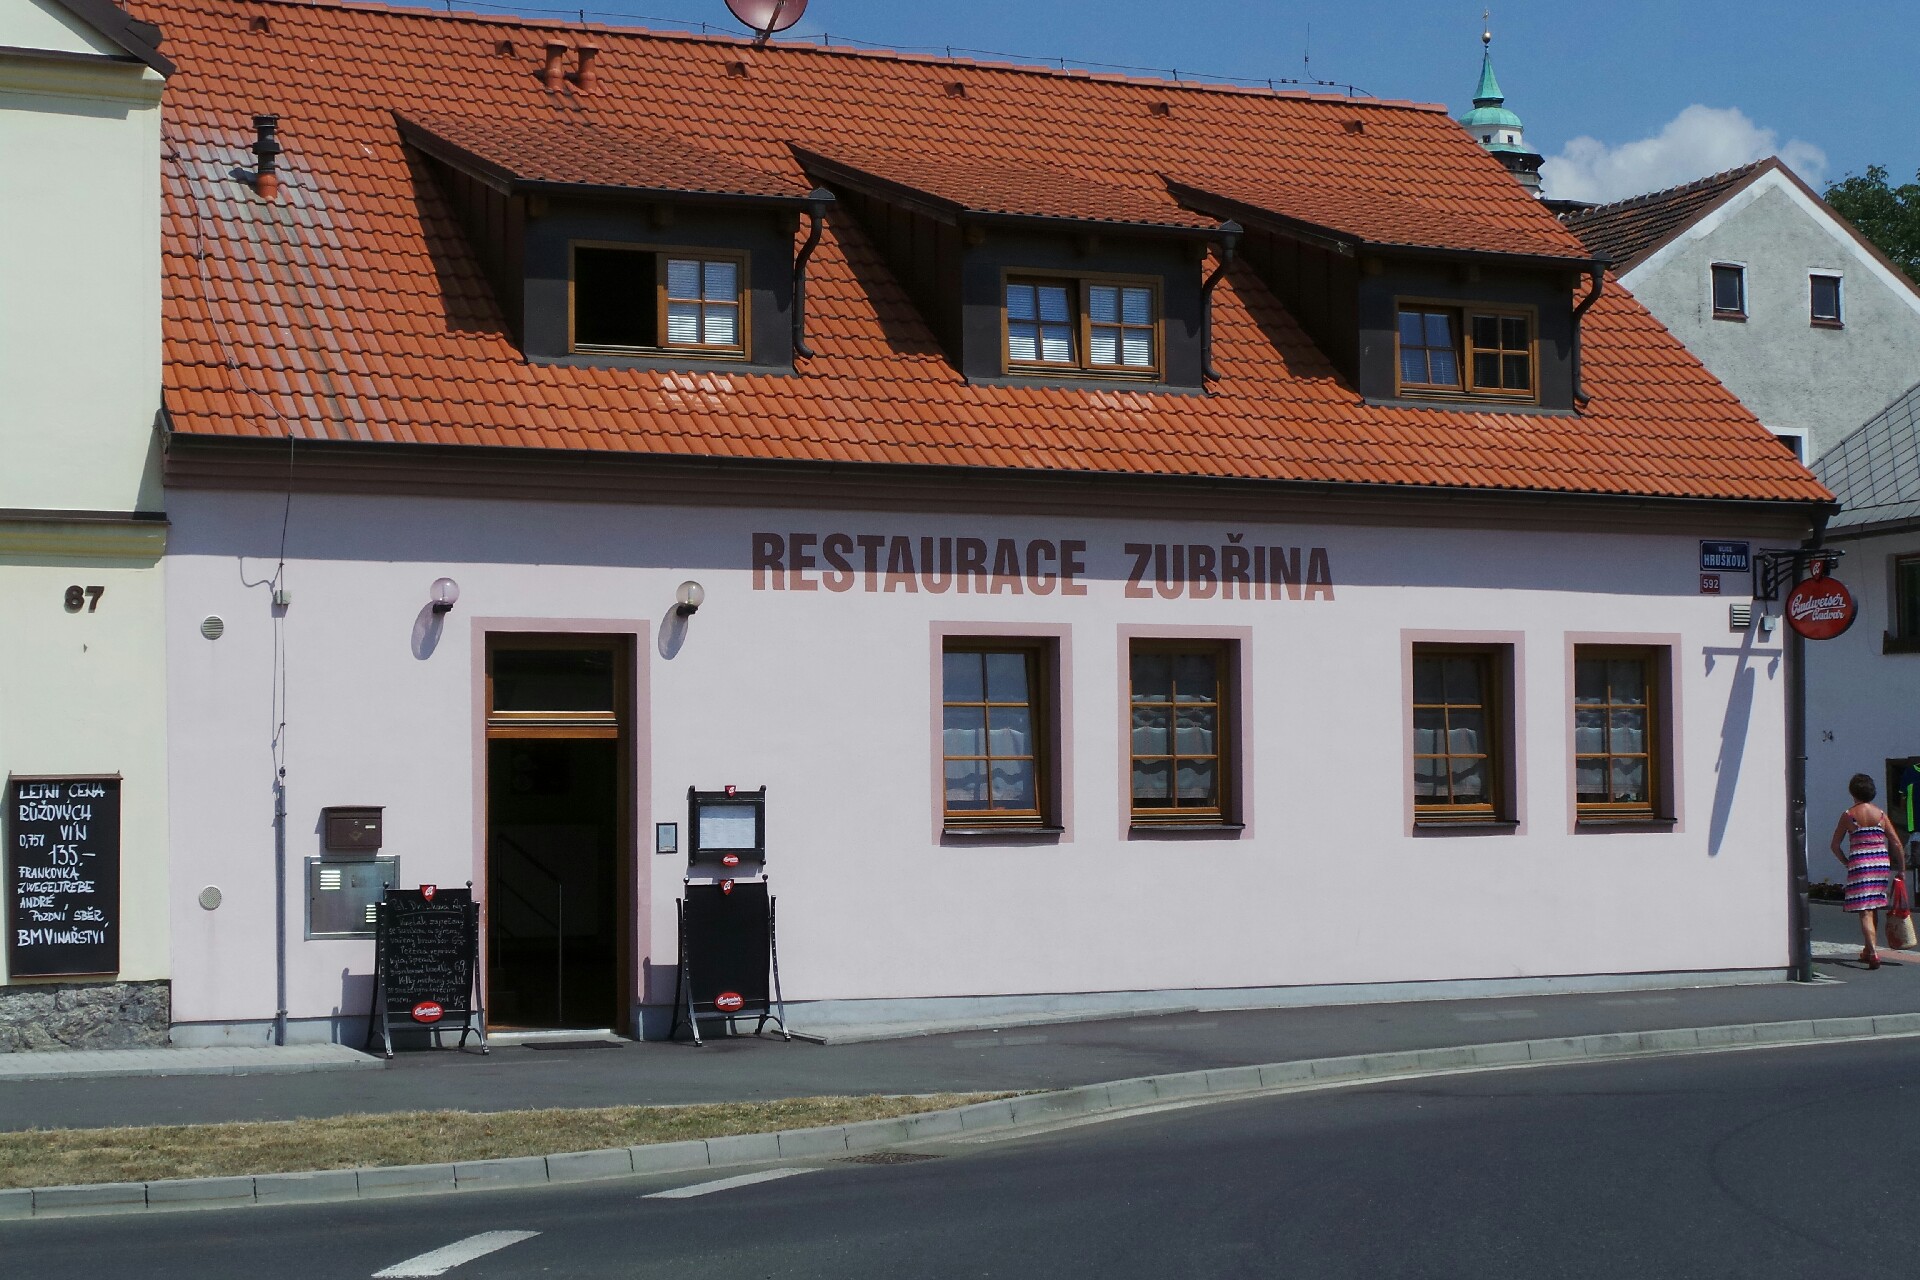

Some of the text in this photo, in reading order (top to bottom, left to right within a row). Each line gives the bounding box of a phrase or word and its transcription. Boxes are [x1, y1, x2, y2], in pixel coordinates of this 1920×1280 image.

[752, 532, 1336, 602] RESTAURACE ZUBŘINA
[1703, 552, 1747, 567] HRUŠKOVA
[1703, 578, 1719, 589] 592
[63, 585, 105, 614] 87
[1791, 593, 1846, 617] Budweiser
[1812, 609, 1845, 621] Budvar
[68, 782, 106, 798] CENA
[18, 799, 92, 821] RŮŽOVÝCH
[60, 821, 87, 841] VÍN
[17, 866, 80, 880] FRANKOVKA
[17, 881, 95, 894] ZWEGELTREBE
[20, 894, 55, 908] ANDRÉ
